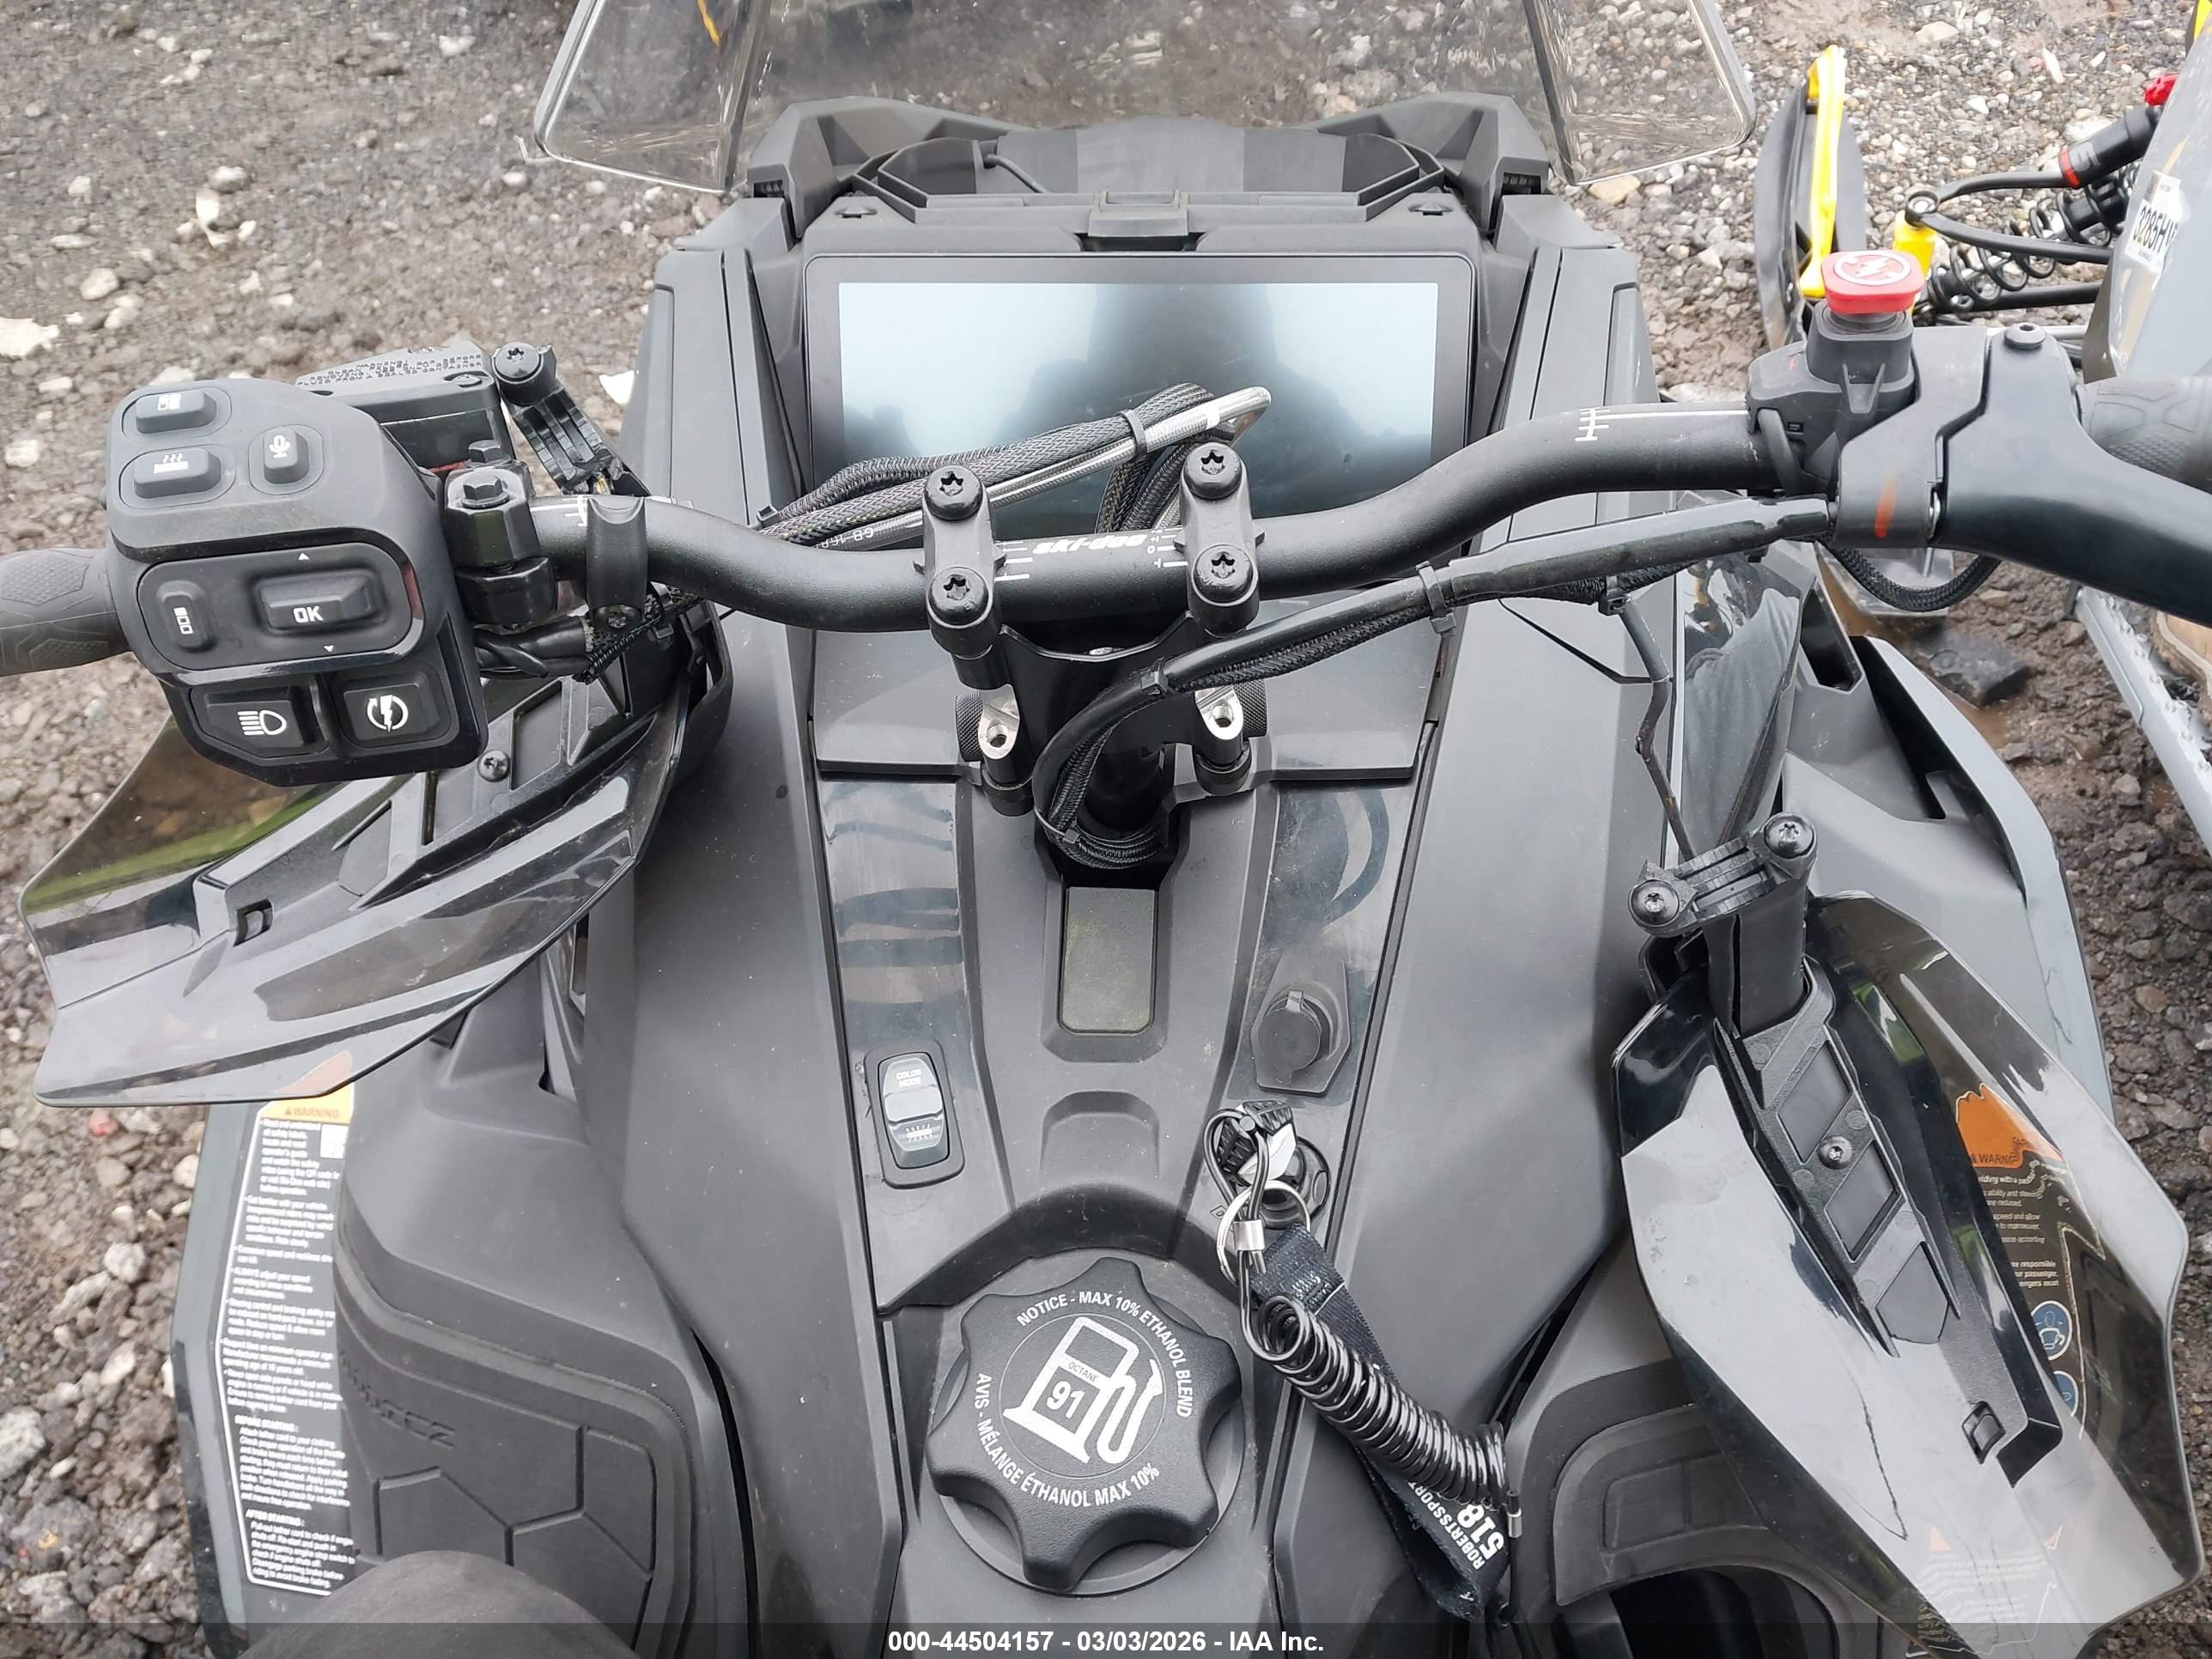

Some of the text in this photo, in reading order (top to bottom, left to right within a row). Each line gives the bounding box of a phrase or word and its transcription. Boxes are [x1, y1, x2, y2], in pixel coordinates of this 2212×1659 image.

[293, 605, 324, 623] OK
[292, 1108, 339, 1118] WARNING
[1016, 1295, 1069, 1327] NOTICE
[1079, 1291, 1113, 1306] MAX
[1115, 1296, 1140, 1318] 10%
[1139, 1310, 1186, 1368] ETHANOL
[1175, 1369, 1194, 1418] BLEND
[974, 1373, 992, 1409] AVIS
[1047, 1380, 1085, 1418] 91
[976, 1418, 1025, 1486] MÉLANGE
[1020, 1472, 1091, 1508] ÉTHANOL
[1130, 1462, 1160, 1491] 10%
[1095, 1483, 1131, 1507] MAX
[1457, 1504, 1504, 1560] 518
